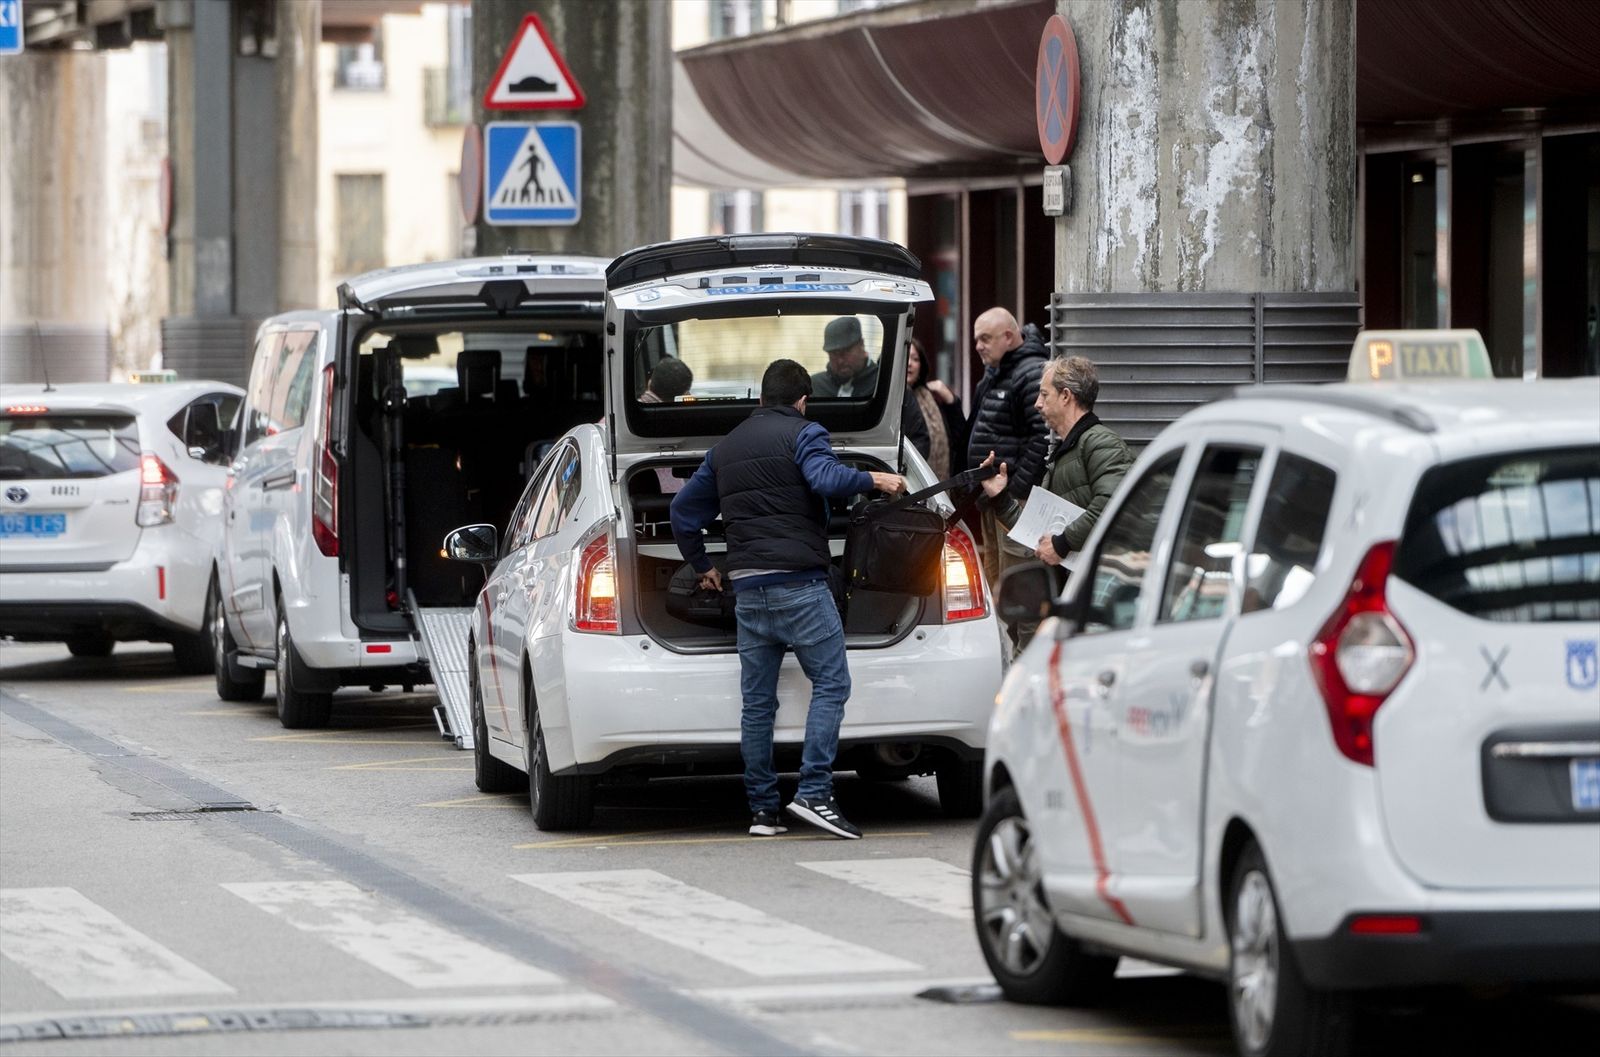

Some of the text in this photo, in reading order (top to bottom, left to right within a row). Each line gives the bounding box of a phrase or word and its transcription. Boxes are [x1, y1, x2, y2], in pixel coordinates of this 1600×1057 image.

[1368, 340, 1460, 379] P TAXI
[1478, 645, 1510, 691] X
